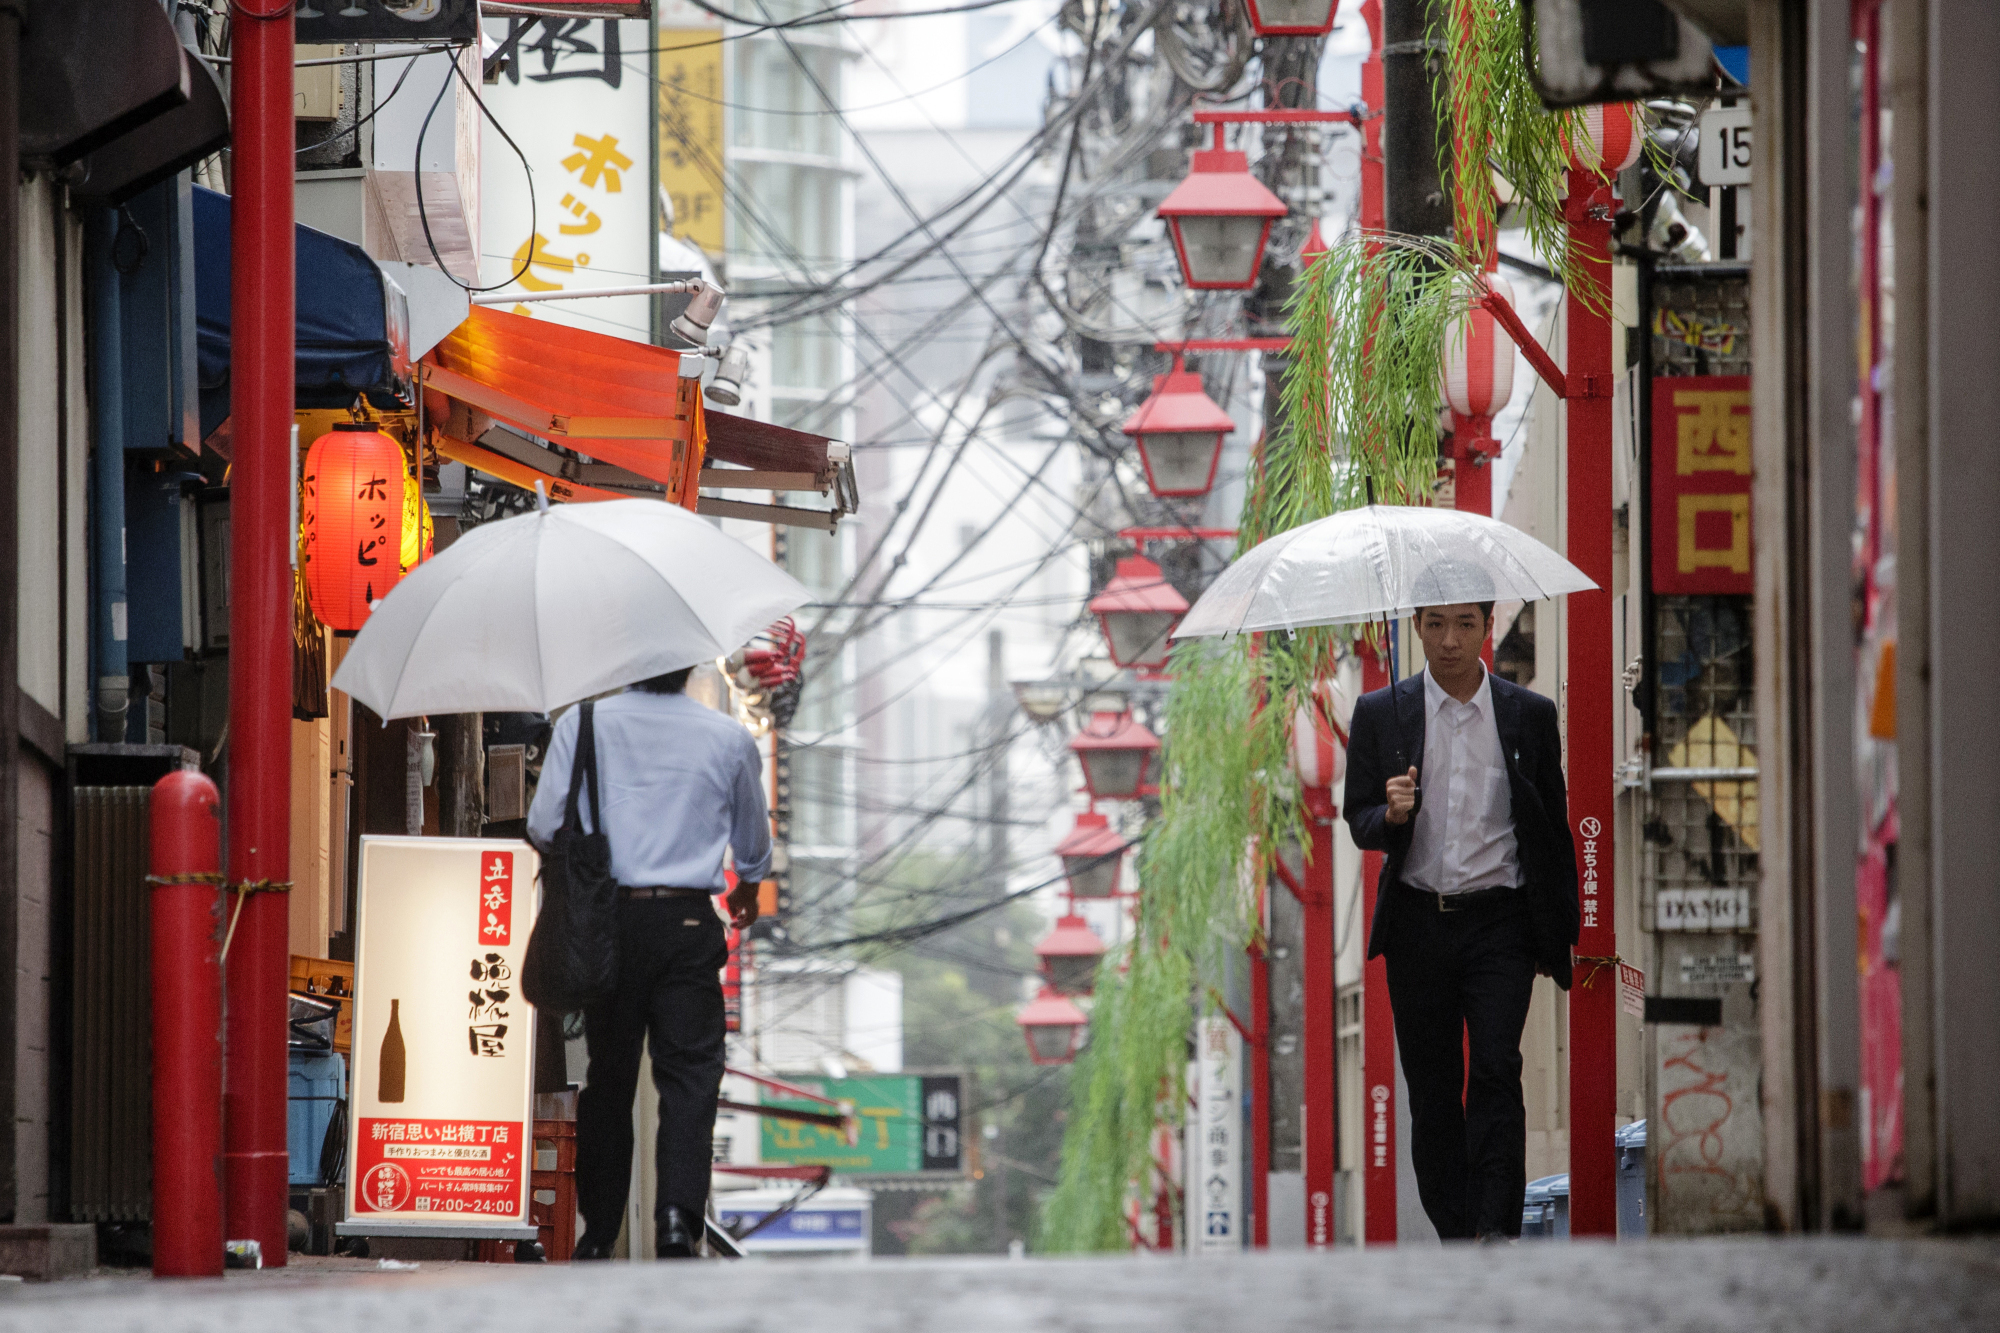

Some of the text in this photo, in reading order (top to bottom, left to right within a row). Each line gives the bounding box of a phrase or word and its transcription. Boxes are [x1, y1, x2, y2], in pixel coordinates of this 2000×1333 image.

[511, 132, 634, 318] ホッピ
[1674, 390, 1752, 574] 西口
[358, 471, 387, 604] ホッピー
[483, 857, 510, 939] 立呑み
[1583, 839, 1598, 927] 立ち小便 禁止
[469, 953, 511, 1058] 晩杯屋
[371, 1122, 509, 1144] 新宿思い出横丁店
[388, 1147, 488, 1158] 手作りおつまみと優良な酒
